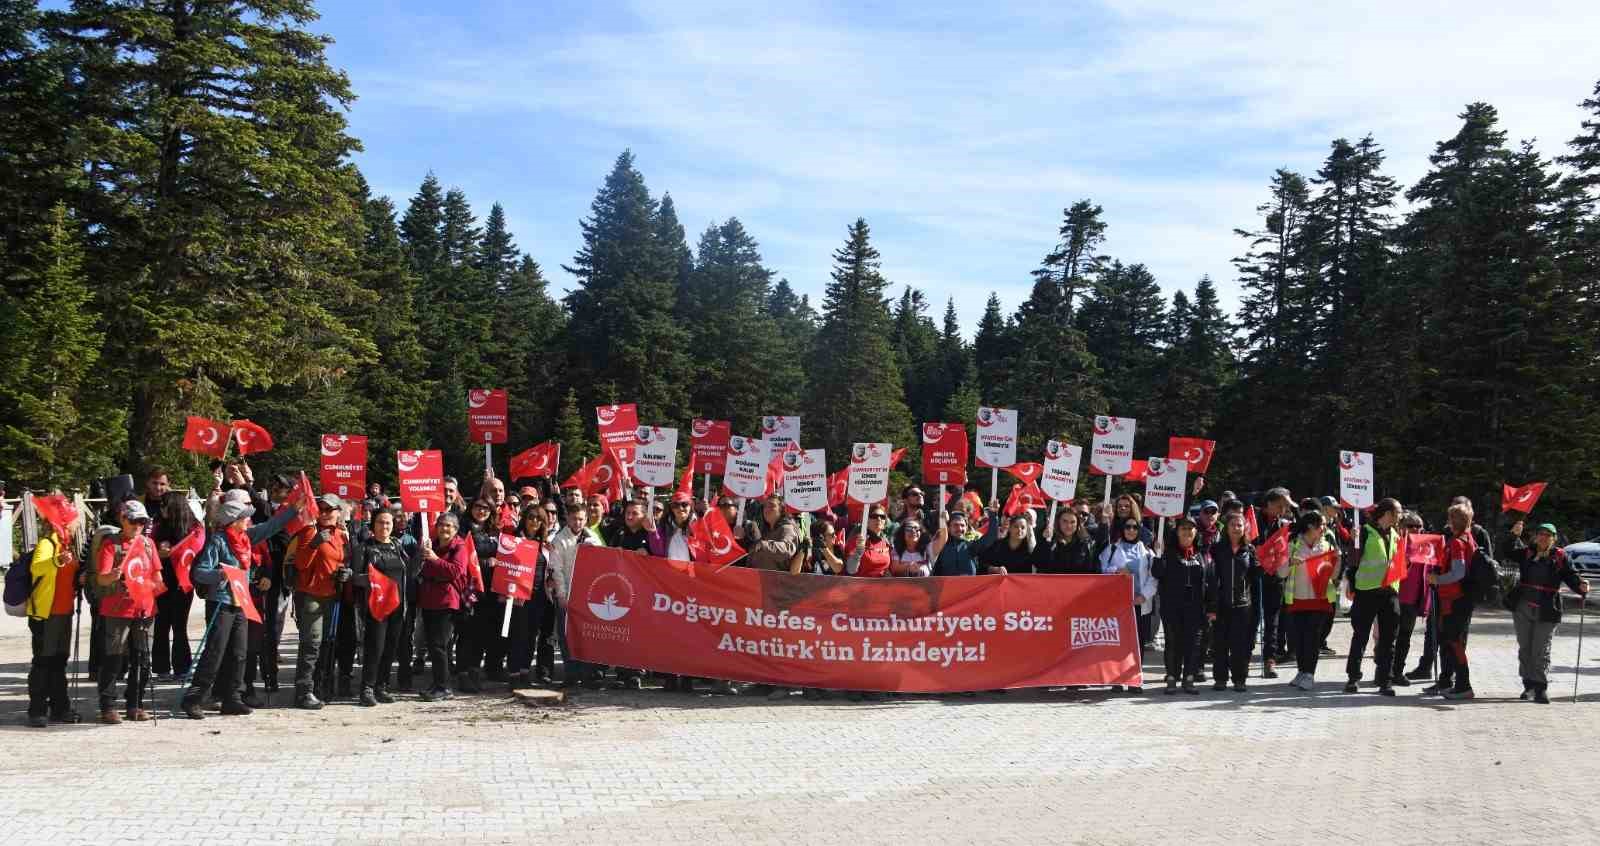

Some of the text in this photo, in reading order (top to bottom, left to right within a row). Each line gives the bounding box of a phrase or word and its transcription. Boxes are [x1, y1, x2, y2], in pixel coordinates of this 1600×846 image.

[652, 592, 1053, 638] Doğaya Nefes, Cumhuriyete Söz:
[1071, 617, 1117, 631] ERKAN
[1073, 629, 1118, 644] AYDIN
[718, 632, 986, 667] Atatürk'ün İzindeyiz!
